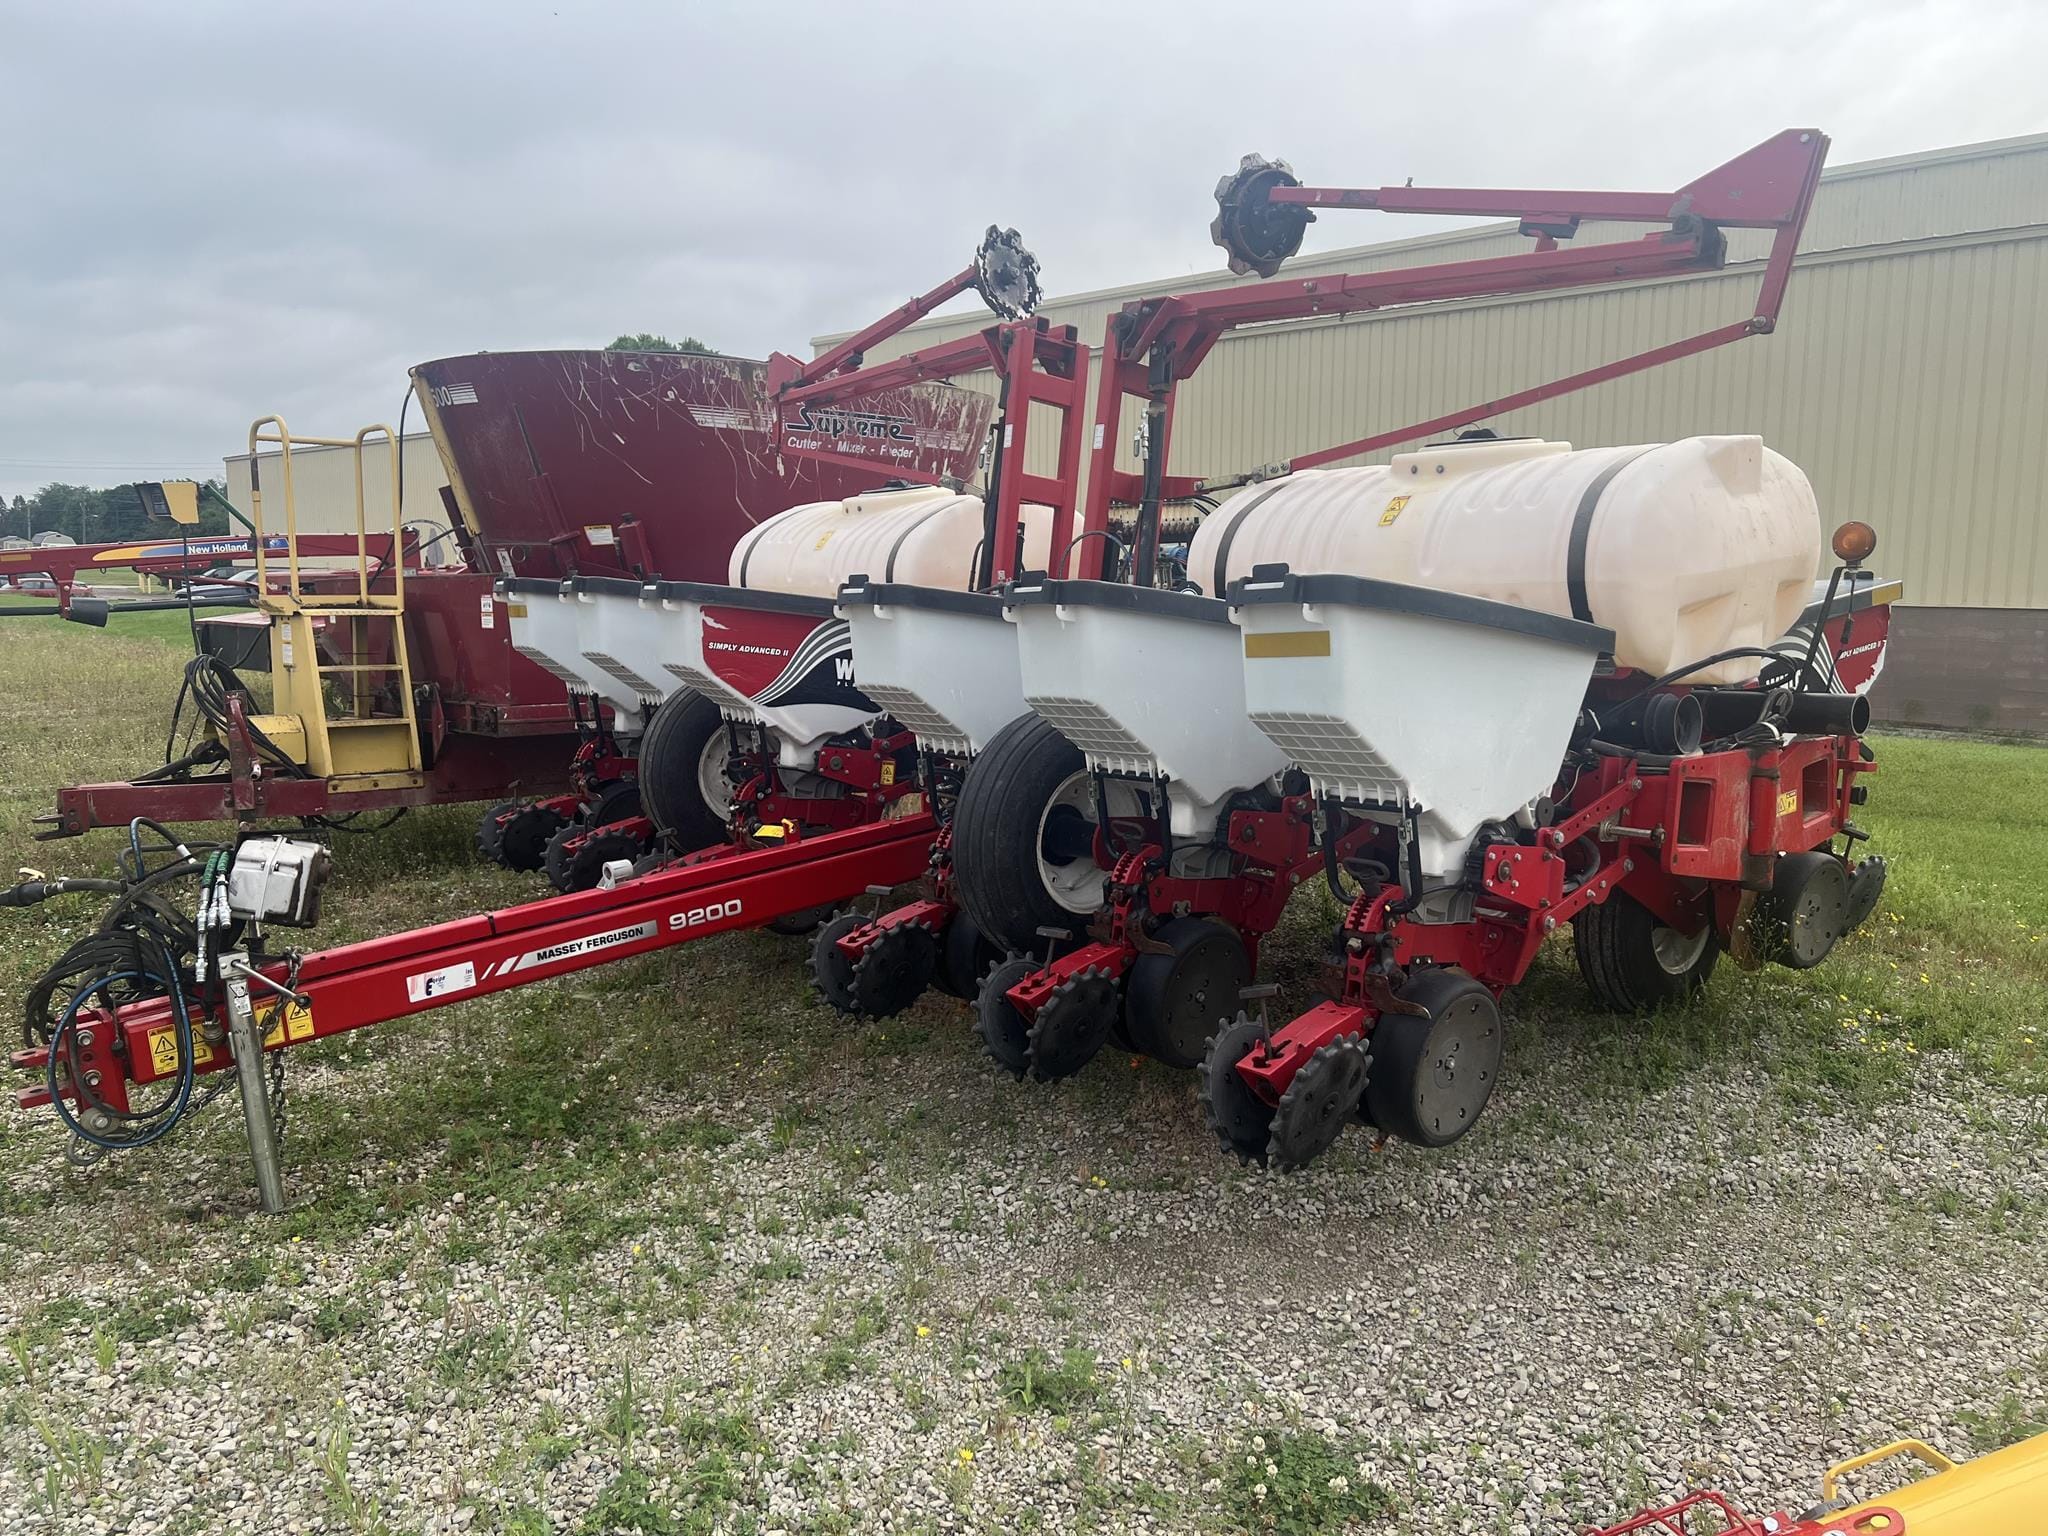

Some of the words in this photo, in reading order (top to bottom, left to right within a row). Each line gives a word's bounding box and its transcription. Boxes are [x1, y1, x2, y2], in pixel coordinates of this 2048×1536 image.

[785, 406, 916, 441] Supreme
[787, 436, 822, 450] Cutter
[837, 441, 867, 454] Mixer
[880, 445, 914, 458] Feder
[188, 545, 210, 555] New
[212, 543, 248, 554] Holland
[708, 642, 738, 652] SIMPLY
[739, 645, 781, 656] ADVANCED
[1853, 641, 1877, 655] ADVANCED
[669, 899, 742, 931] 9200
[536, 942, 583, 961] MASSEY
[586, 927, 644, 949] FERGUSON
